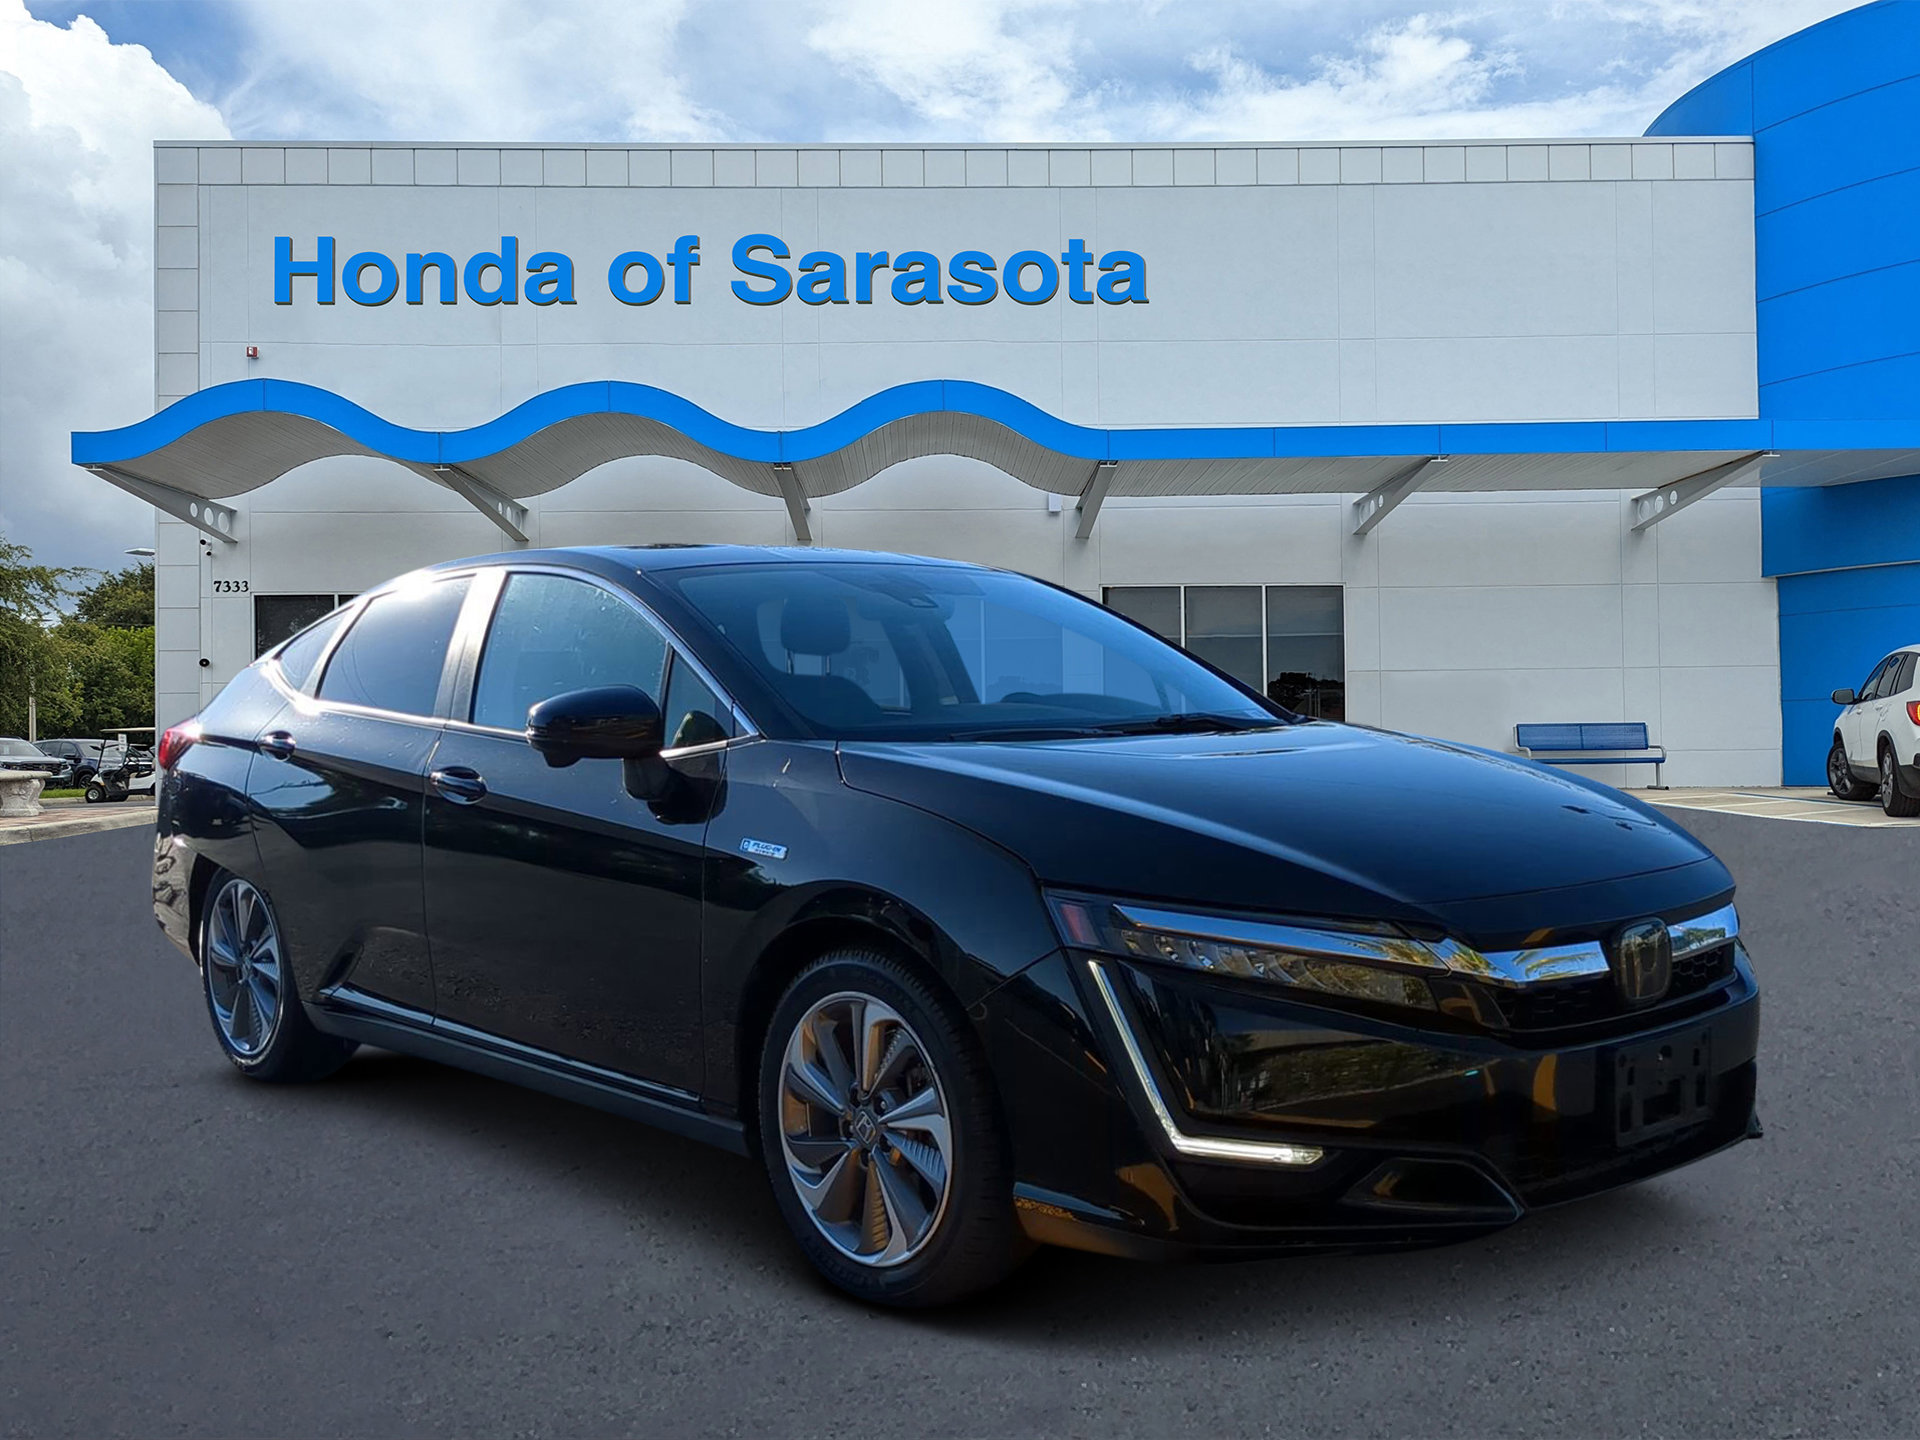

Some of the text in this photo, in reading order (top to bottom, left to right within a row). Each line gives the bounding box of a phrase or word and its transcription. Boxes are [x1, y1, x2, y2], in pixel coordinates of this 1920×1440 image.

[274, 233, 1150, 306] Honda of Sarasota
[213, 580, 249, 593] 7333
